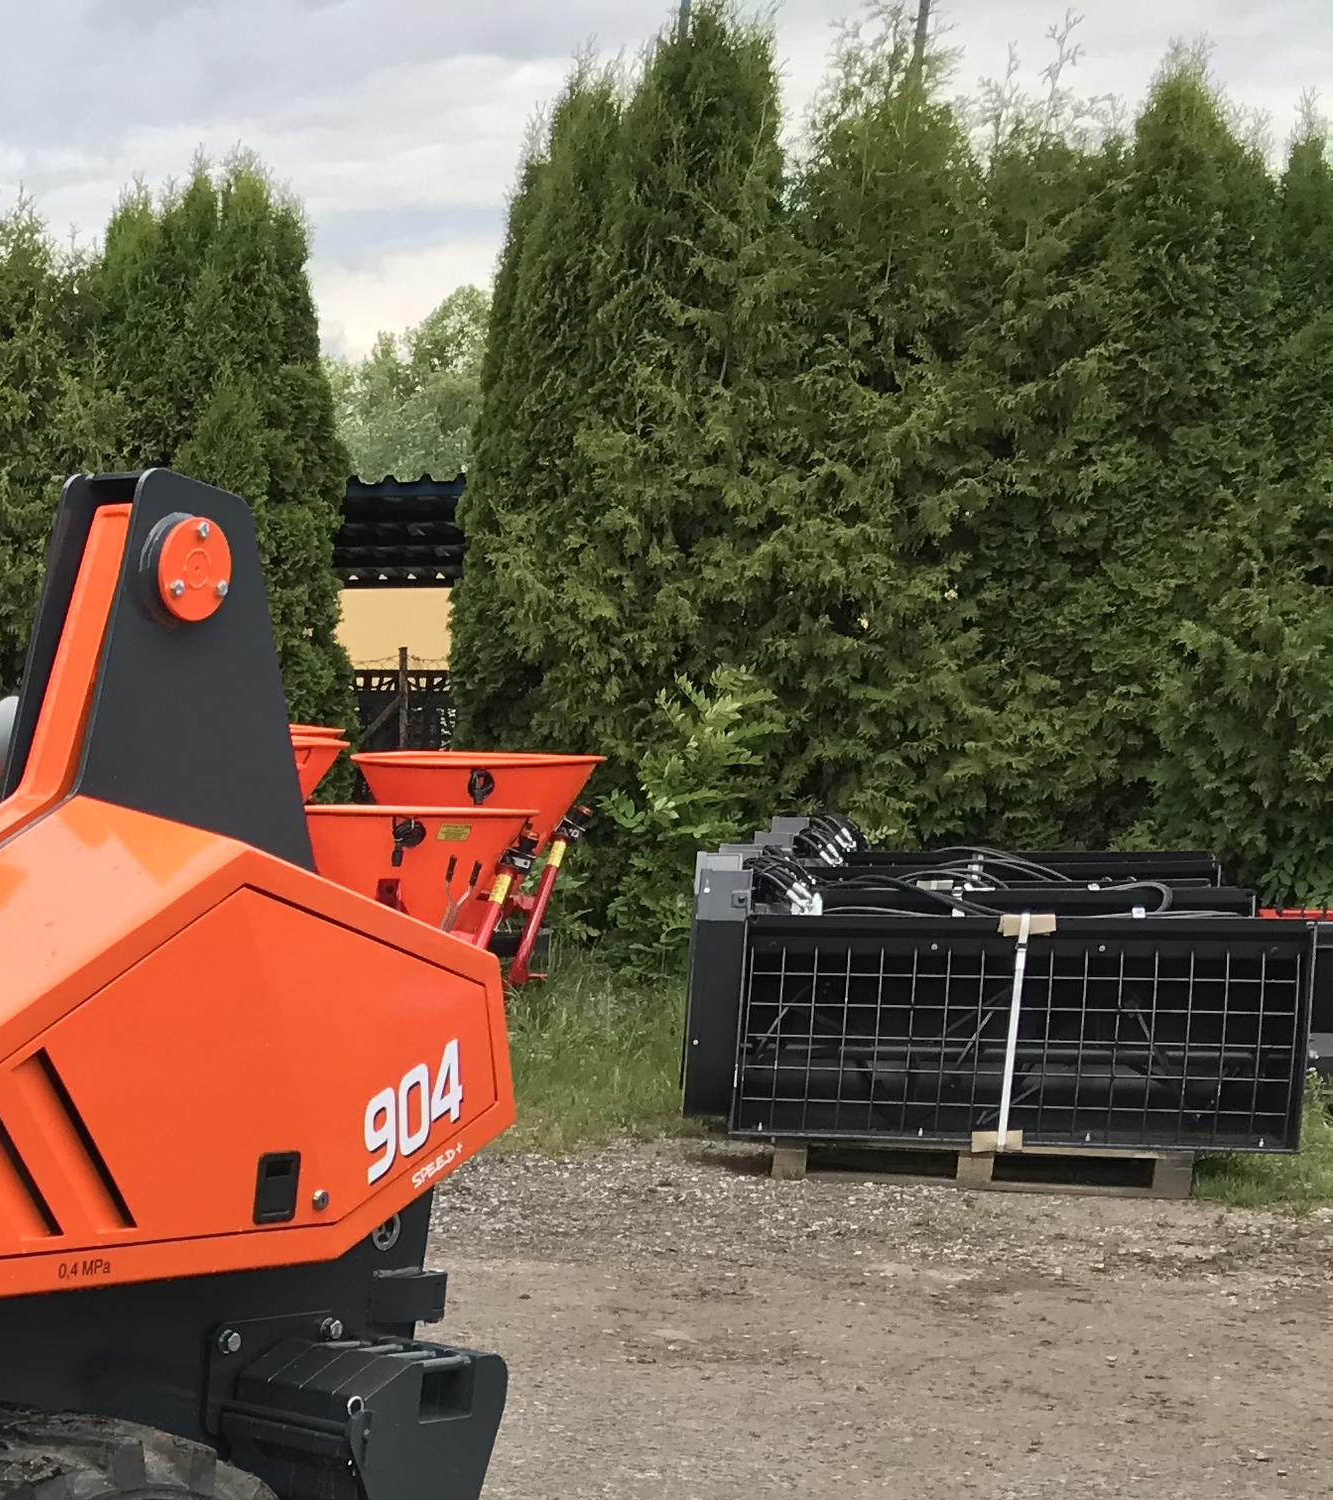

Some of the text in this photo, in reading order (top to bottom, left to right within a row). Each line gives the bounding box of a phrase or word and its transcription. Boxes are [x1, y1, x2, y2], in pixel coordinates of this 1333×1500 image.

[364, 1038, 463, 1185] 904
[58, 1258, 111, 1279] 0,4 MPa
